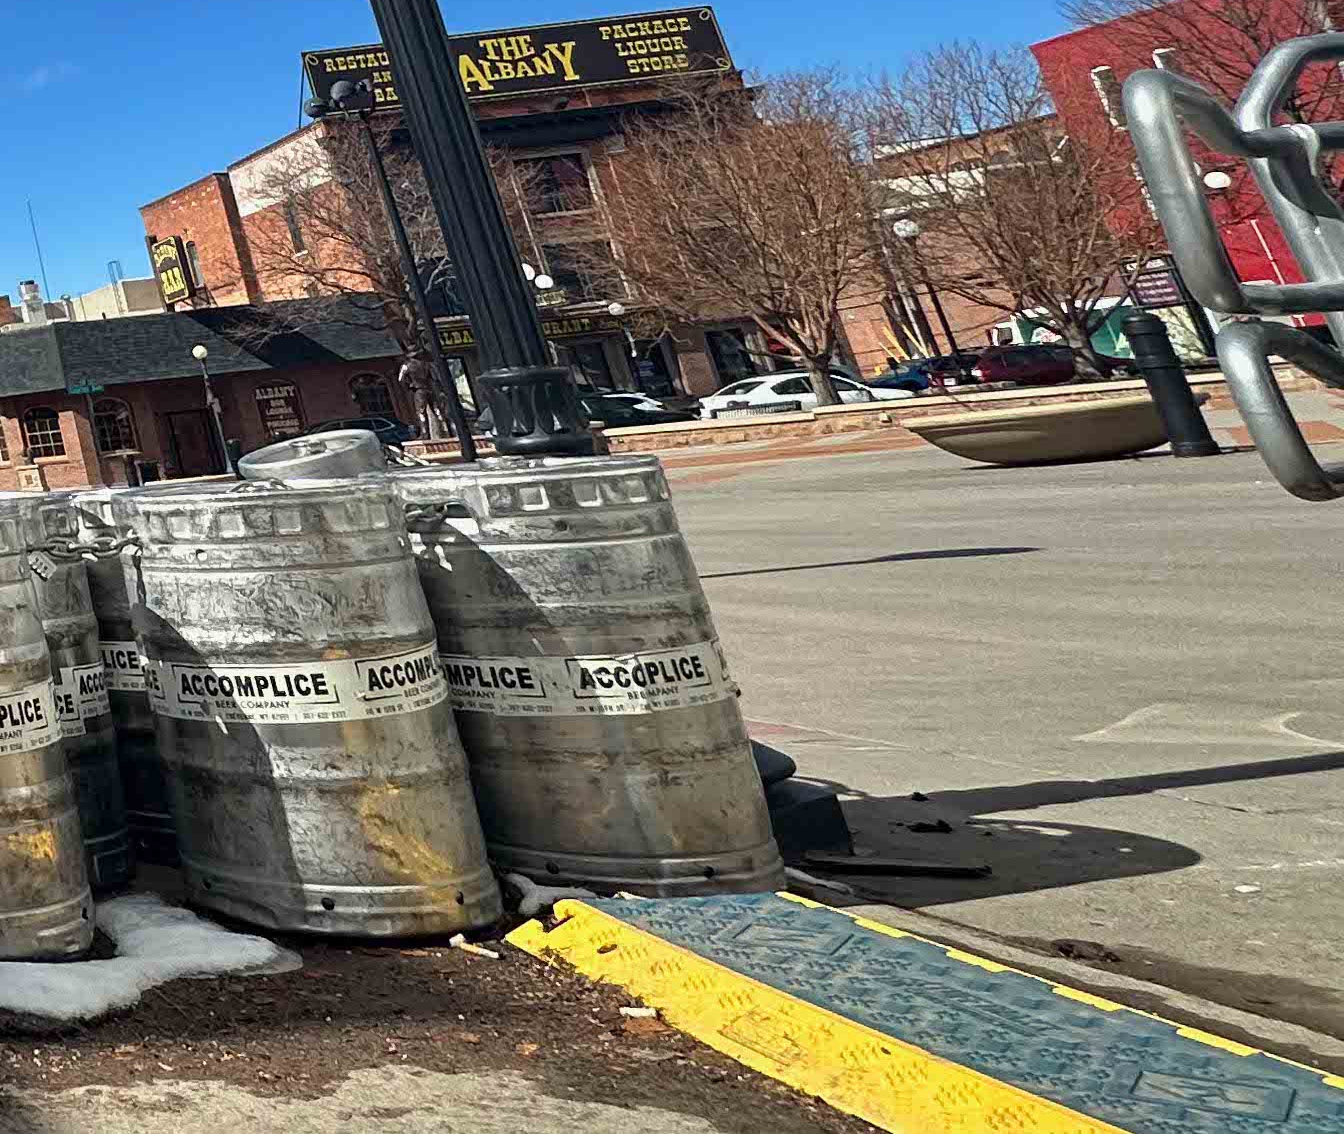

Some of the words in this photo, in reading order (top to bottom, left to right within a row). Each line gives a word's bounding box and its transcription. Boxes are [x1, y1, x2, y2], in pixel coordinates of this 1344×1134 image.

[599, 17, 692, 40] PACKAGE
[479, 34, 535, 61] THE
[614, 36, 689, 56] LIQUOR
[458, 40, 580, 93] ALBANY
[627, 53, 690, 74] STORE
[181, 672, 329, 697] ACCOMPLICE
[240, 700, 291, 709] COMPANY
